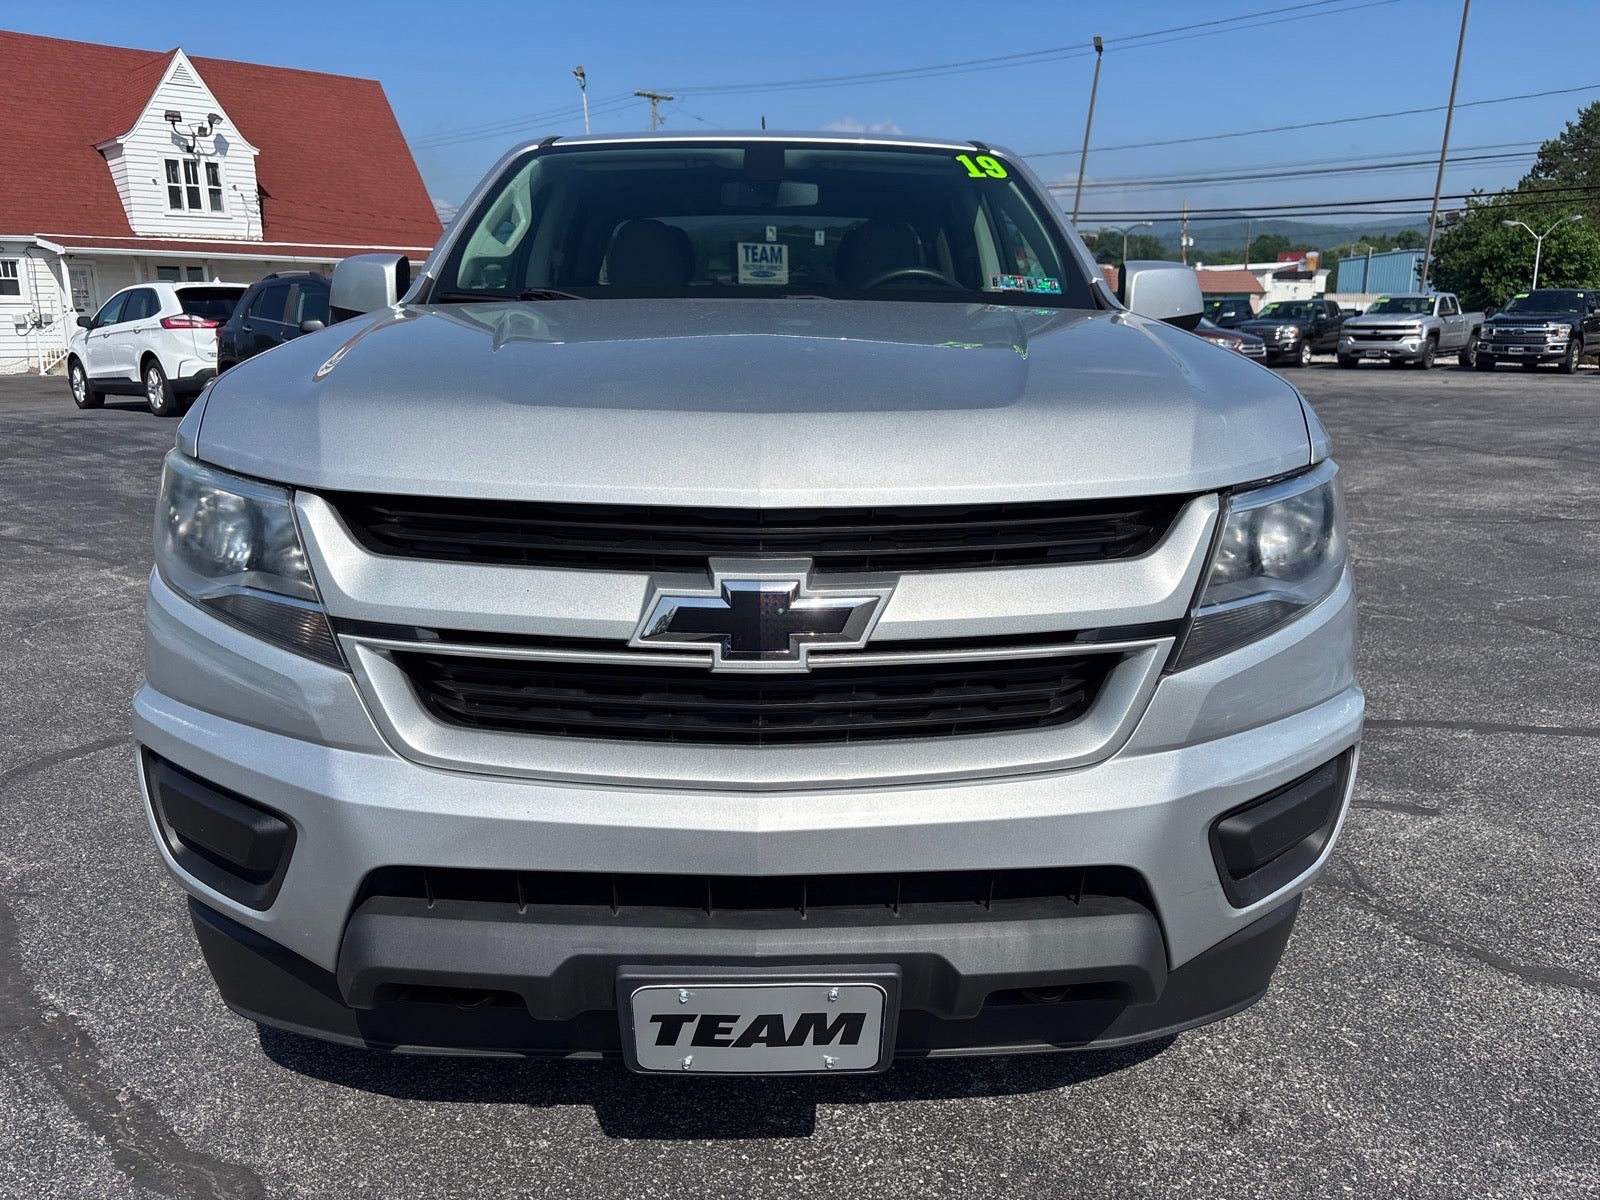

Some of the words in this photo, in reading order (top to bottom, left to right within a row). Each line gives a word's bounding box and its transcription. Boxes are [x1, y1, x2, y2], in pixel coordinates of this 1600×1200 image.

[955, 154, 1008, 179] 19
[743, 245, 783, 264] TEAM
[649, 1012, 867, 1048] TEAM
